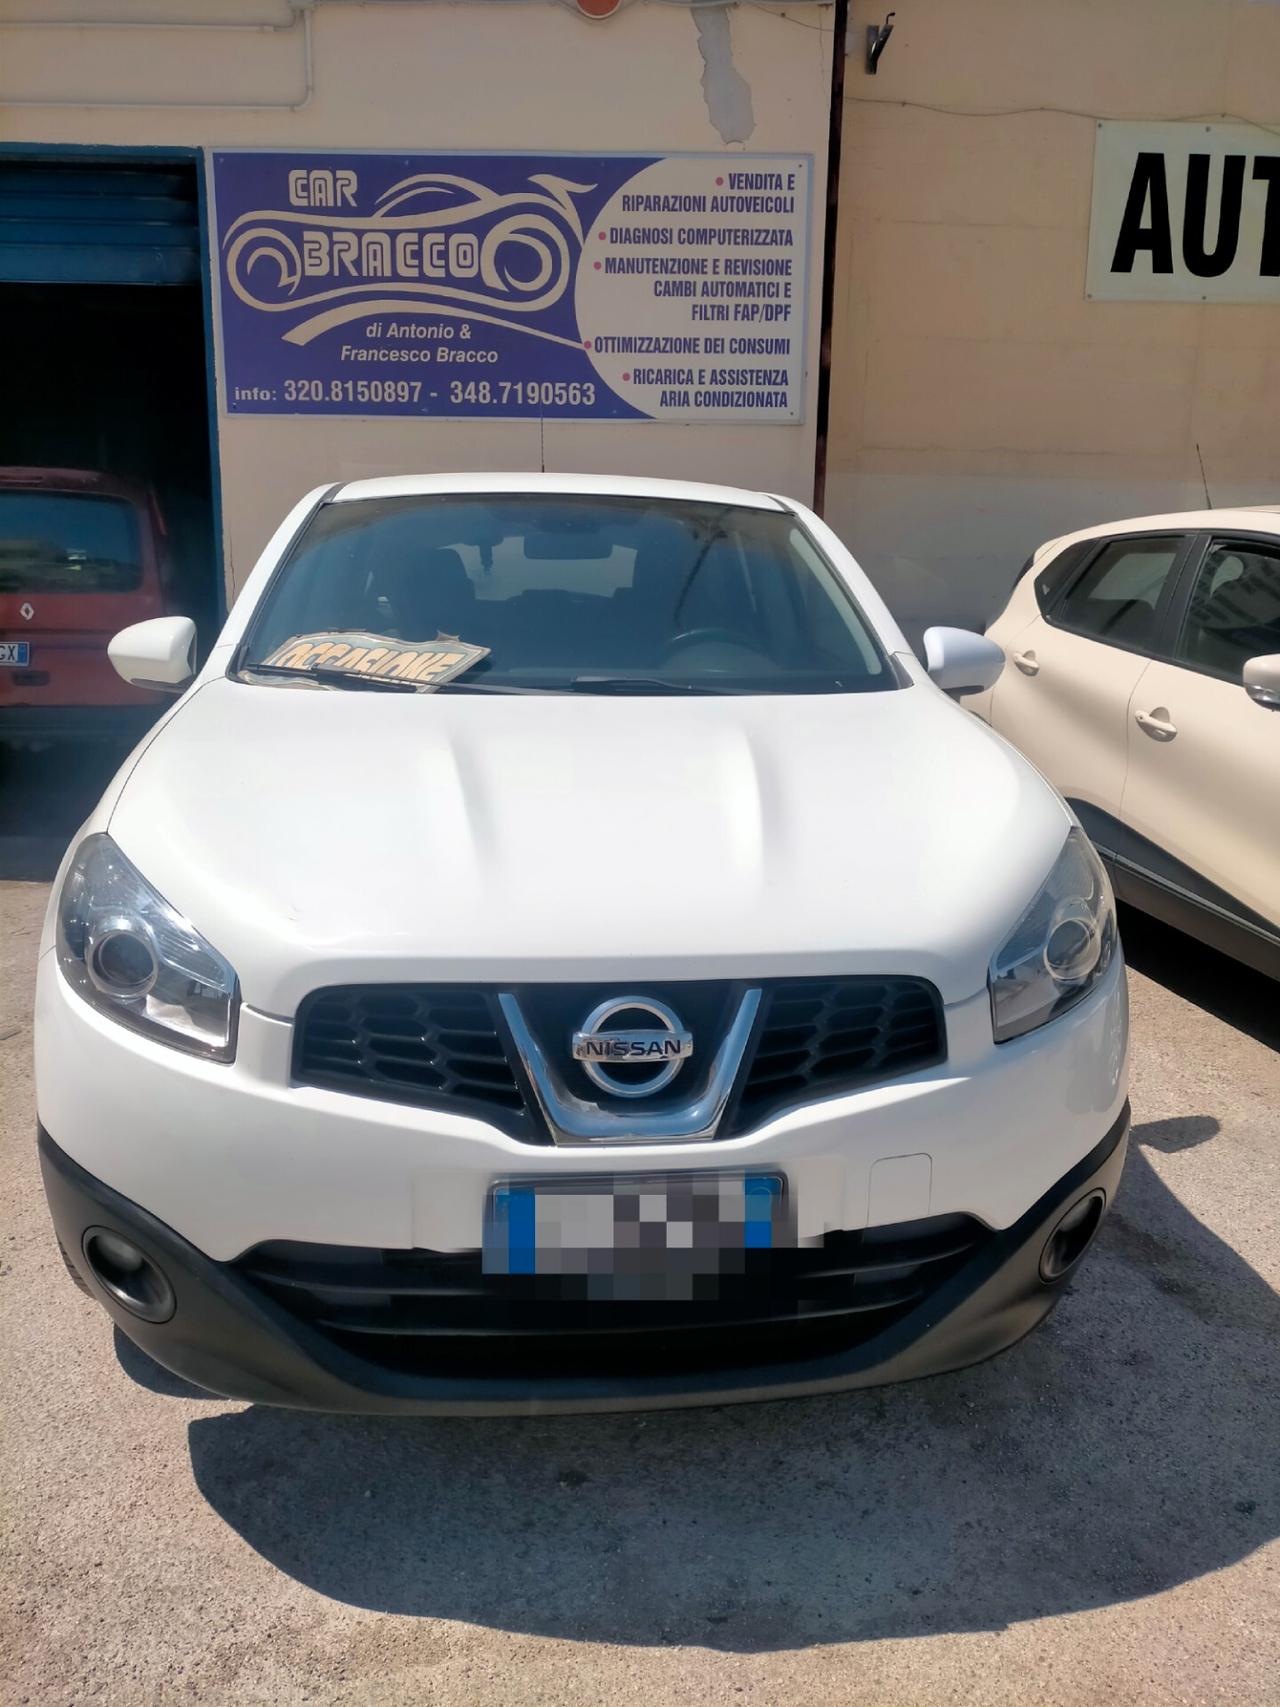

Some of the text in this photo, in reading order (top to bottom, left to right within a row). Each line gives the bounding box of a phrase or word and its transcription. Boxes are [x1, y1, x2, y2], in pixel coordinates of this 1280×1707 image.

[289, 169, 358, 207] CAR
[729, 173, 795, 190] VENDITA E
[622, 195, 794, 213] RIPARAZIONI AUTOVEICOLI
[1110, 152, 1280, 277] AUT
[610, 227, 793, 246] DIAGNOSI COMPUTERIZZATA
[303, 231, 480, 278] BRACCO
[605, 257, 792, 276] MANUTENZIONE E REVISIONE
[654, 280, 791, 298] CAMBI AUTOMATICI E
[692, 304, 791, 323] FILTRI FAP/DPF
[366, 323, 472, 340] di Antonio &
[595, 336, 790, 355] OTTIMIZZAZIONE DEI CONSUMI
[341, 346, 499, 364] Francesco Bracco
[634, 368, 789, 386] RICARICA E ASSISTENZA
[235, 387, 277, 401] info:
[284, 380, 422, 403] 320.8150897
[450, 381, 595, 406] 348.7190563
[660, 391, 788, 408] ARIA CONDIZIONATA
[586, 1040, 681, 1056] NISSAN
